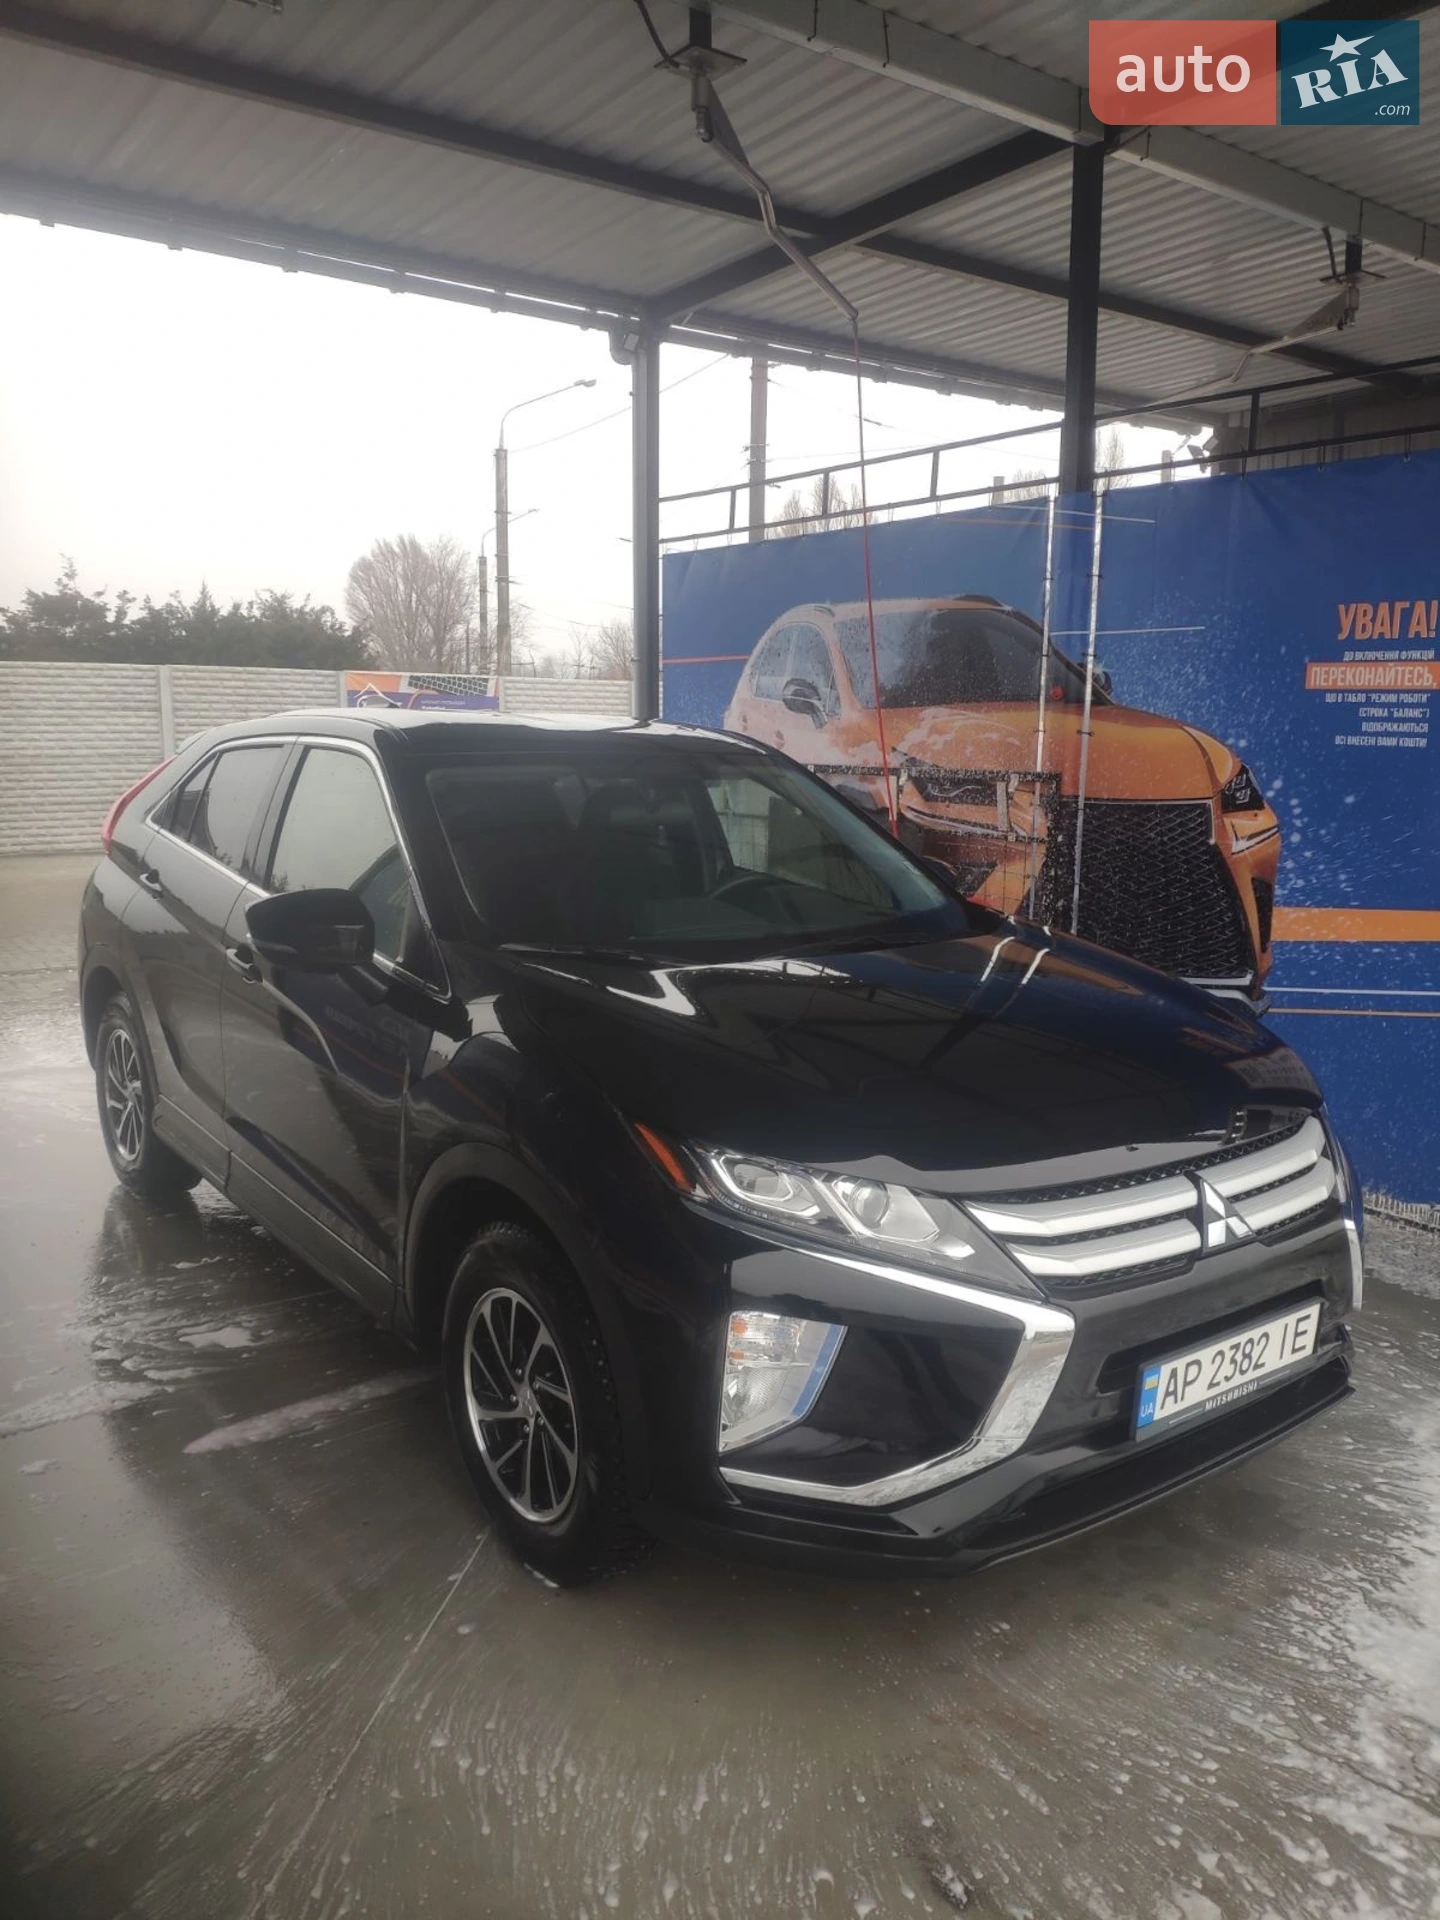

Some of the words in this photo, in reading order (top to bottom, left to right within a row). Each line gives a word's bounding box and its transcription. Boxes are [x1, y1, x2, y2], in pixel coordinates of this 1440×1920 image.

[1337, 600, 1439, 640] УВАГА!
[1311, 663, 1438, 689] ПЕРЕКОНАЙТЕСЬ,
[1344, 693, 1366, 703] ТАБЛО
[1160, 1359, 1202, 1410] AP
[1206, 1331, 1270, 1391] 2382
[1279, 1314, 1312, 1360] IE
[1140, 1402, 1153, 1417] UA
[1205, 1380, 1258, 1411] MITSUBISHI
